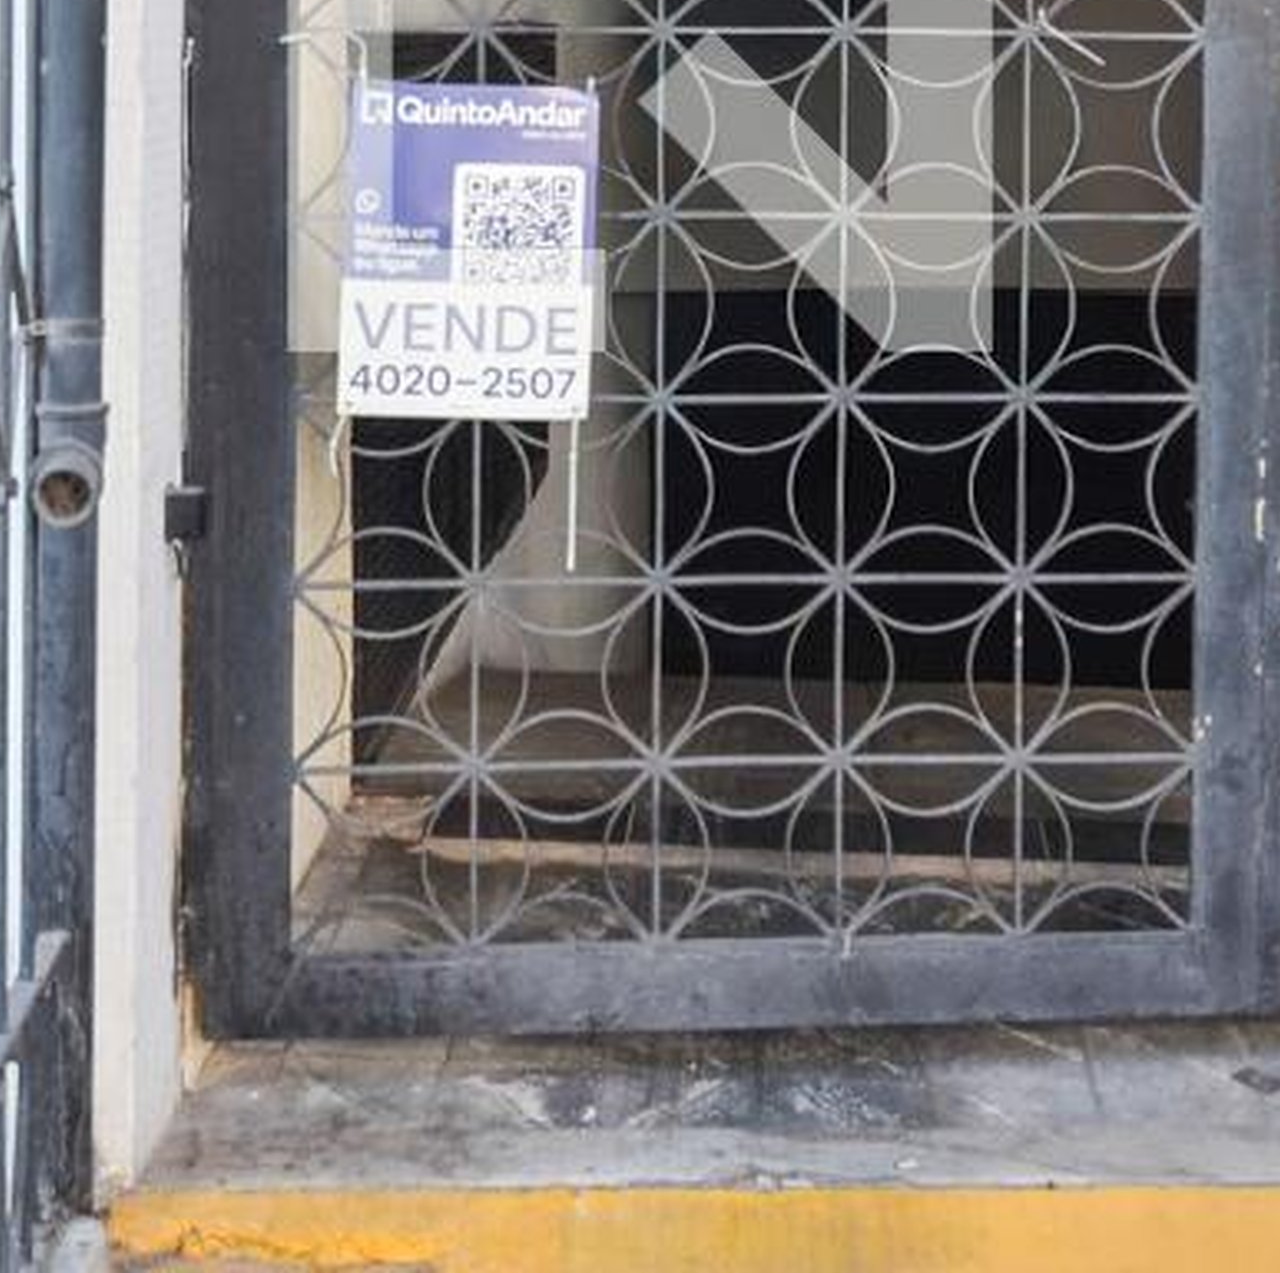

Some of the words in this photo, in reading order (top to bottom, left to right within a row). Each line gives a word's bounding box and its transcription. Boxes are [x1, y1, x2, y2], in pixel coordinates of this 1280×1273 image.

[397, 94, 587, 127] QuintoAndar
[354, 300, 578, 356] VENDE
[349, 363, 577, 399] 4020-2507
